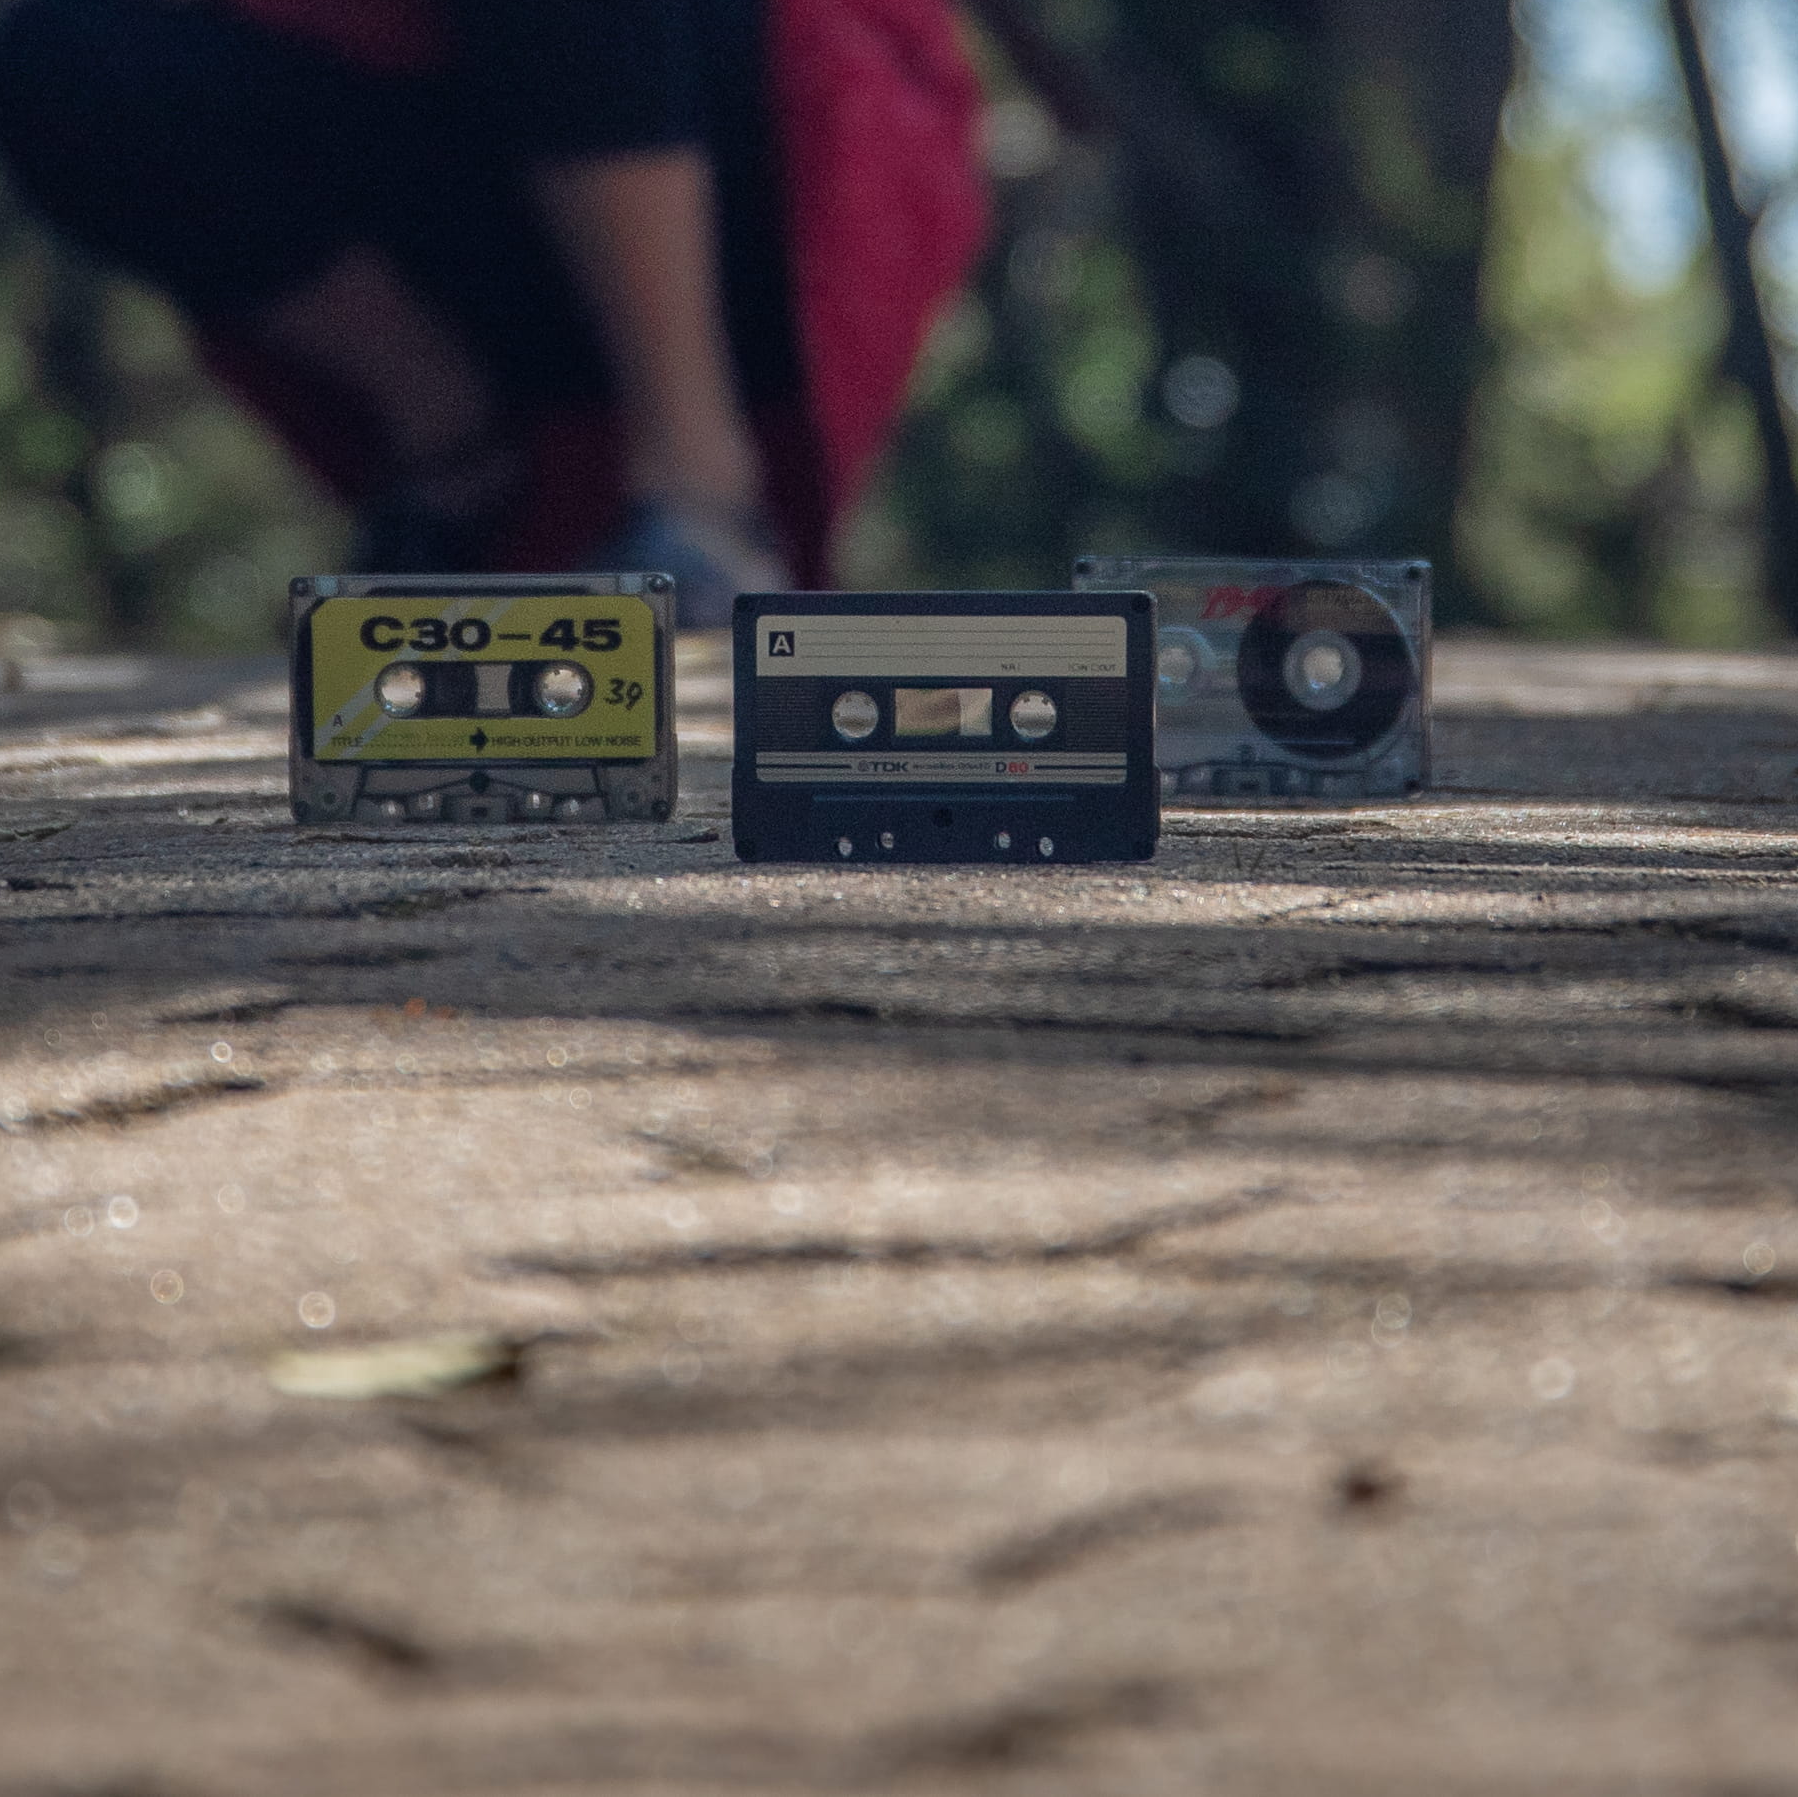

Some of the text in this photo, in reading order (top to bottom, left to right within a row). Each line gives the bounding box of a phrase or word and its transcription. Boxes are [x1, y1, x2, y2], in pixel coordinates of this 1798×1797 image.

[772, 633, 791, 654] A
[333, 714, 343, 727] A
[491, 735, 642, 747] HIGH OUTPUT LOW NOISE
[869, 761, 909, 773] TDK
